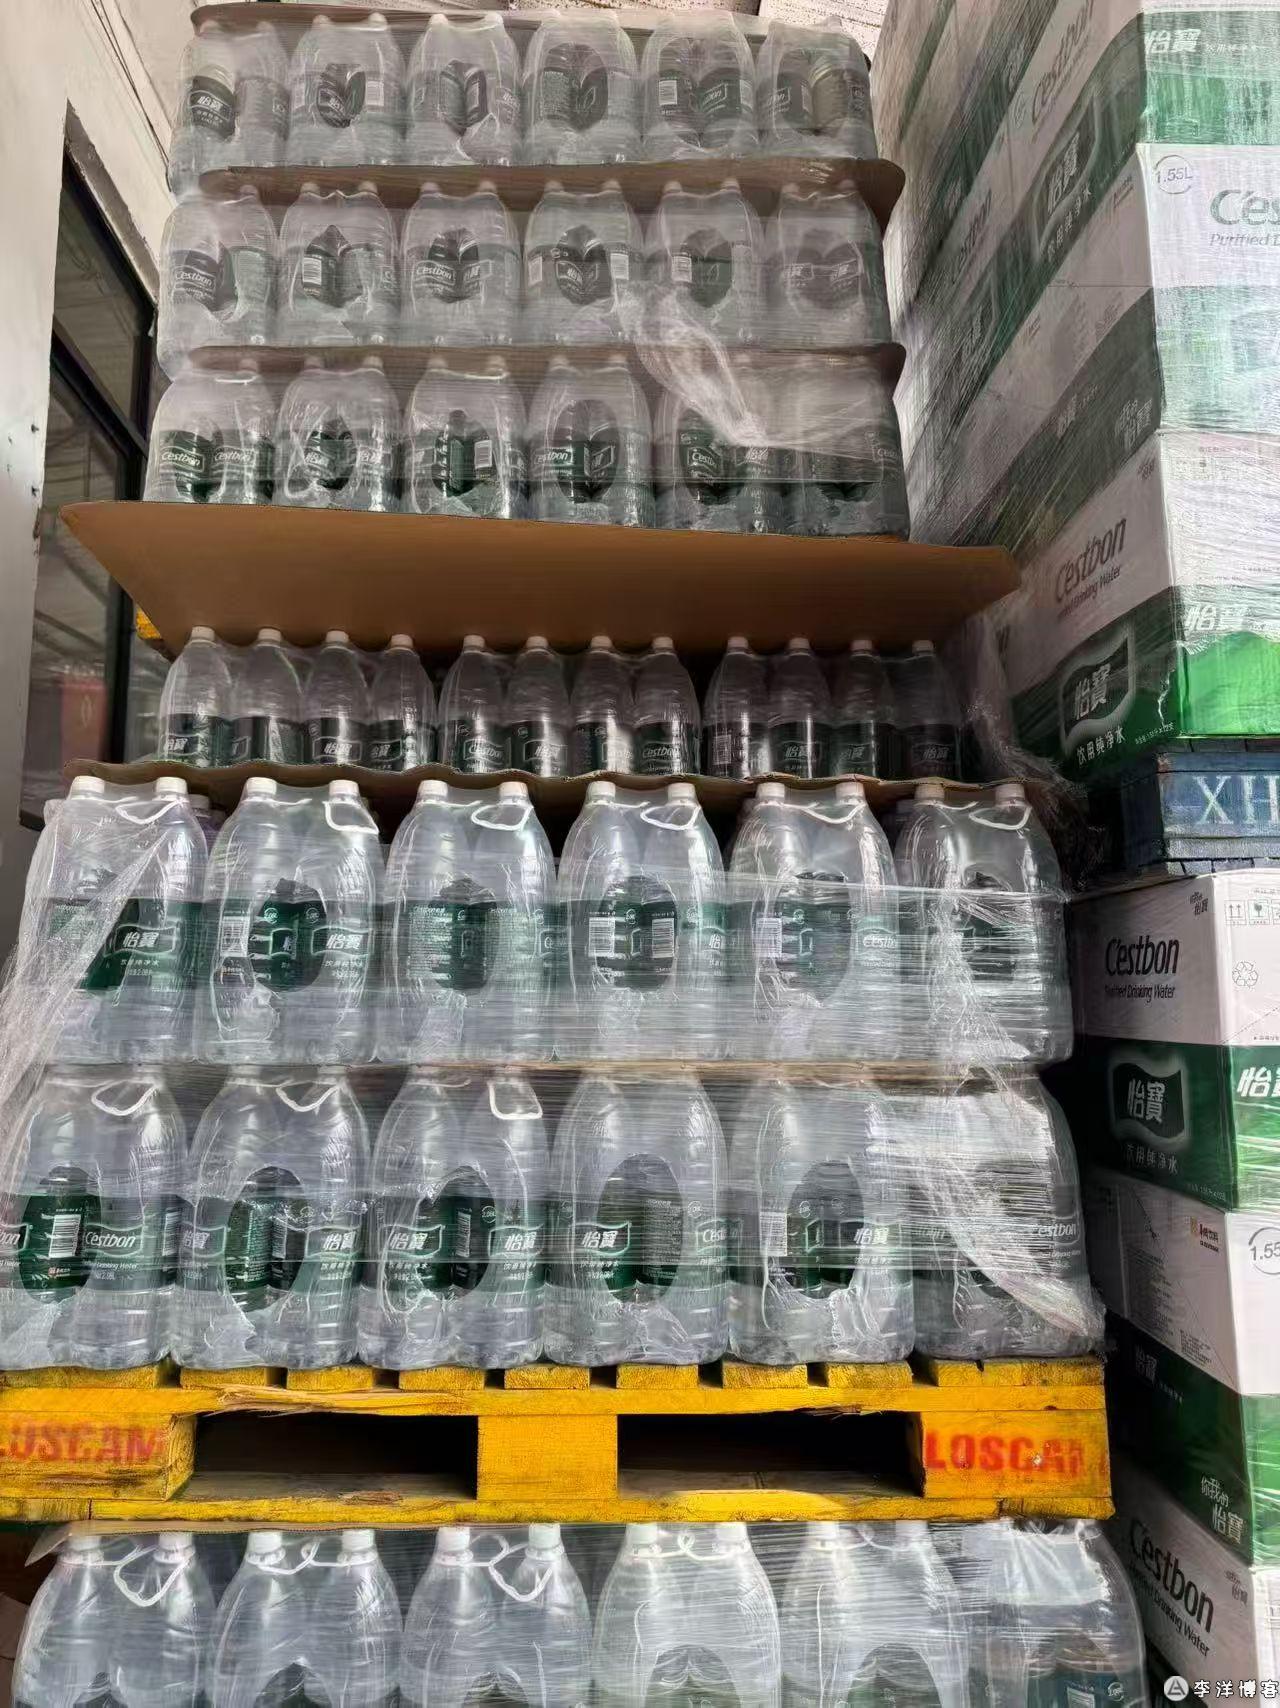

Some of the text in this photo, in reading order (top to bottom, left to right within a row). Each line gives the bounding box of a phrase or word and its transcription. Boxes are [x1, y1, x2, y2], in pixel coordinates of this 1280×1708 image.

[1155, 167, 1193, 184] 1.55L
[1210, 233, 1269, 247] Purified
[1074, 663, 1111, 720] 怡寶
[1077, 726, 1126, 765] 饮用纯净水
[123, 931, 160, 948] 怡寶
[326, 934, 364, 949] 怡寶
[1105, 934, 1180, 976] C'estbon
[1154, 984, 1177, 998] Water
[1127, 1078, 1166, 1123] 怡寶
[85, 1231, 137, 1249] C'estbon
[389, 1232, 428, 1251] 怡寶
[504, 1232, 537, 1251] 怡寶
[581, 1231, 618, 1249] 怡寶
[853, 1227, 889, 1245] 怡寶
[1201, 1475, 1229, 1508] 你我的
[1212, 1504, 1244, 1545] 怡寶
[1130, 1519, 1214, 1633] C'estbon
[1183, 1624, 1210, 1657] Water
